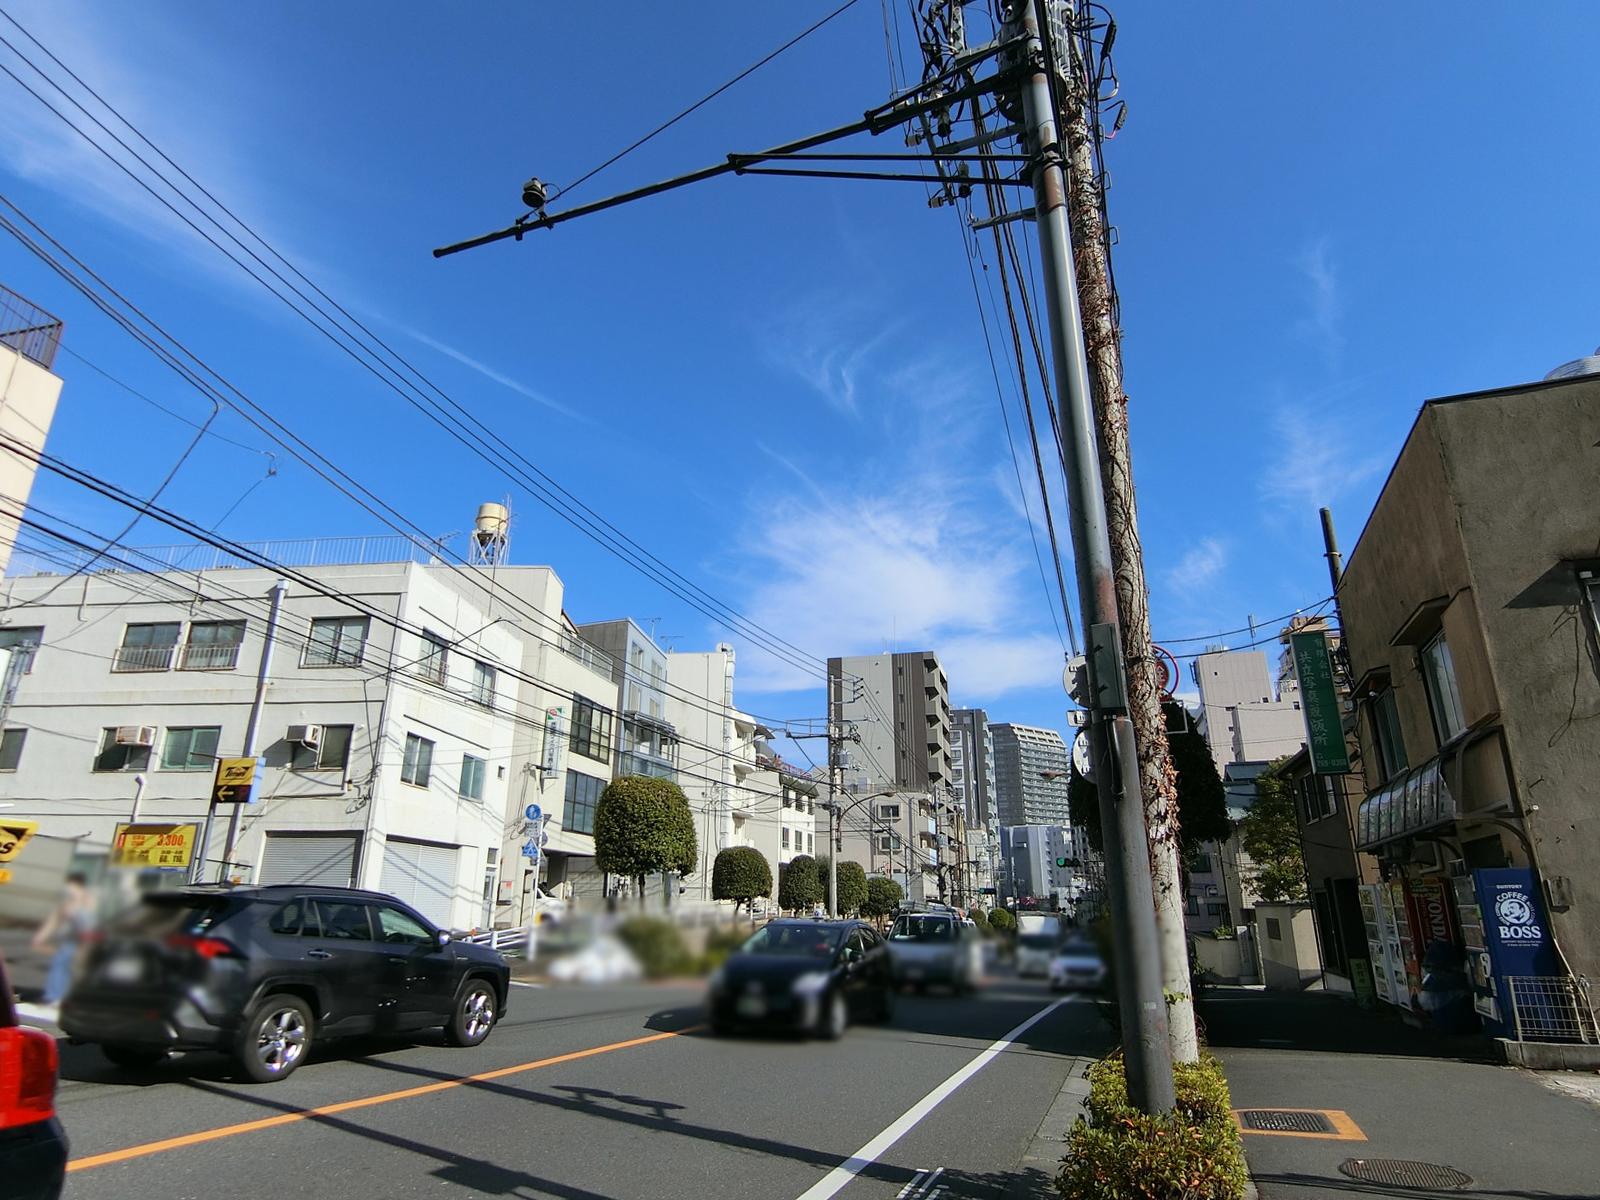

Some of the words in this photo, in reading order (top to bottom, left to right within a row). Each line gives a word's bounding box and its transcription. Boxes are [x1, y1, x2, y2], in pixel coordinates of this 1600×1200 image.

[1313, 638, 1331, 679] 有限会社
[157, 834, 184, 846] 3,300
[1496, 891, 1529, 902] COFFEE
[1498, 926, 1542, 939] BOSS
